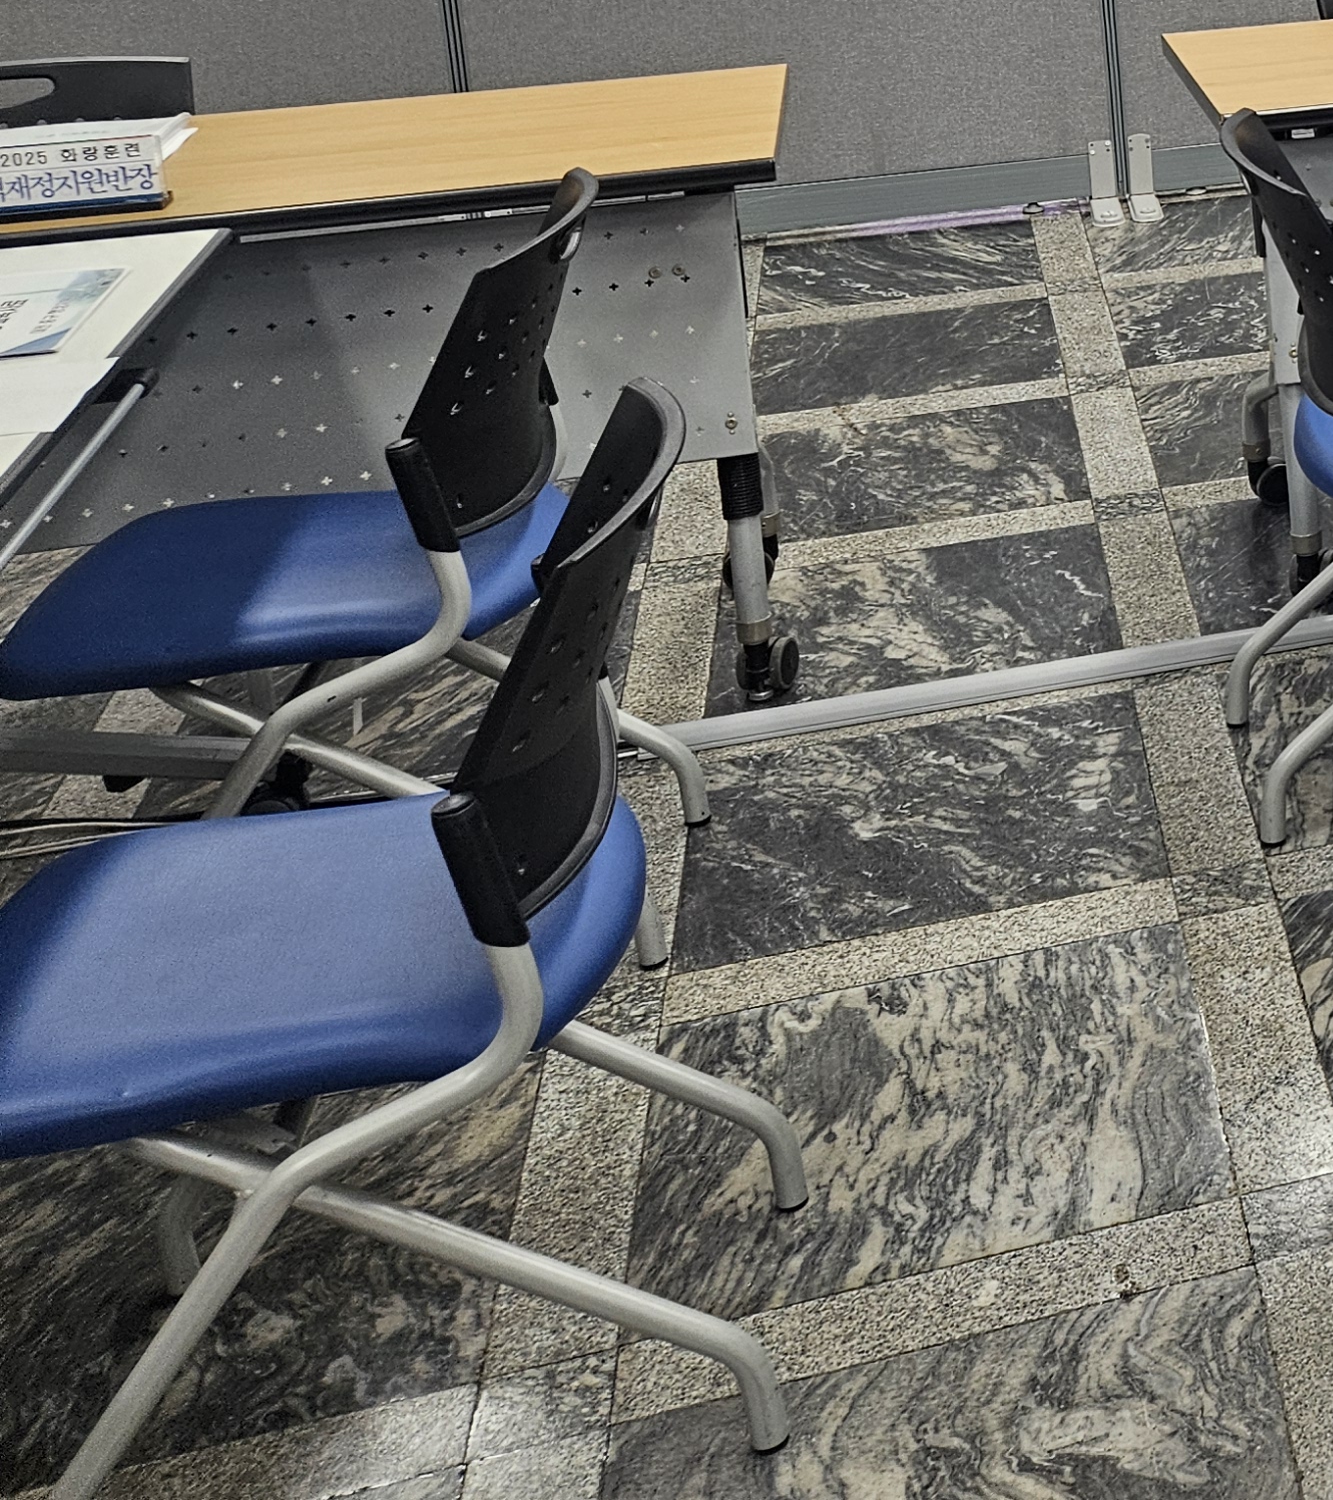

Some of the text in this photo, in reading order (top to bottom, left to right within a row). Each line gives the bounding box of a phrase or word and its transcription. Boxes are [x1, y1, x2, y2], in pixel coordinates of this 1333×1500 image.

[0, 143, 142, 167] 2025 화랑훈련
[0, 163, 159, 201] 재정지원반장
